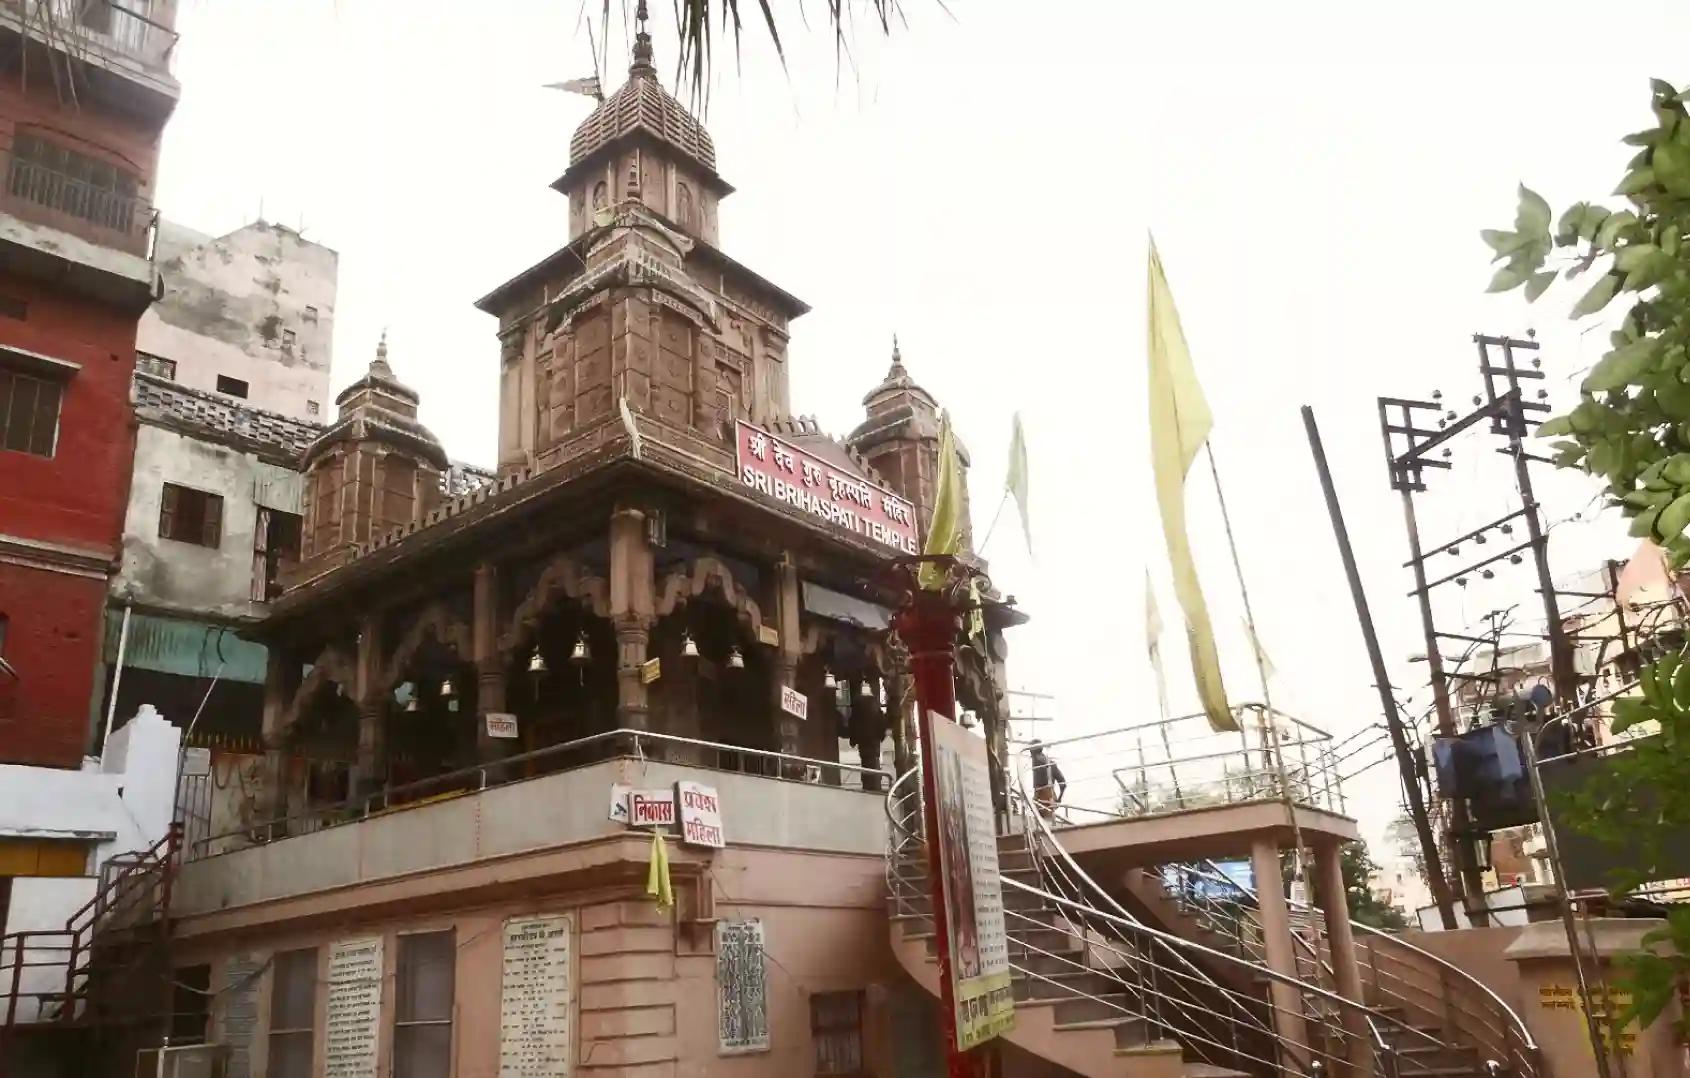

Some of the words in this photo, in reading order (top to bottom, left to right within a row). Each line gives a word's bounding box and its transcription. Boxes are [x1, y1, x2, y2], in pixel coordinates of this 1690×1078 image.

[748, 432, 766, 461] श्री
[772, 439, 794, 473] देव
[827, 472, 873, 511] बृहस्पति
[882, 495, 911, 527] मंदिर
[743, 465, 773, 496] SRI
[775, 481, 859, 532] BRIHASPATI
[860, 518, 917, 552] TEMPLE
[634, 795, 673, 821] निकास
[685, 817, 722, 845] महिला
